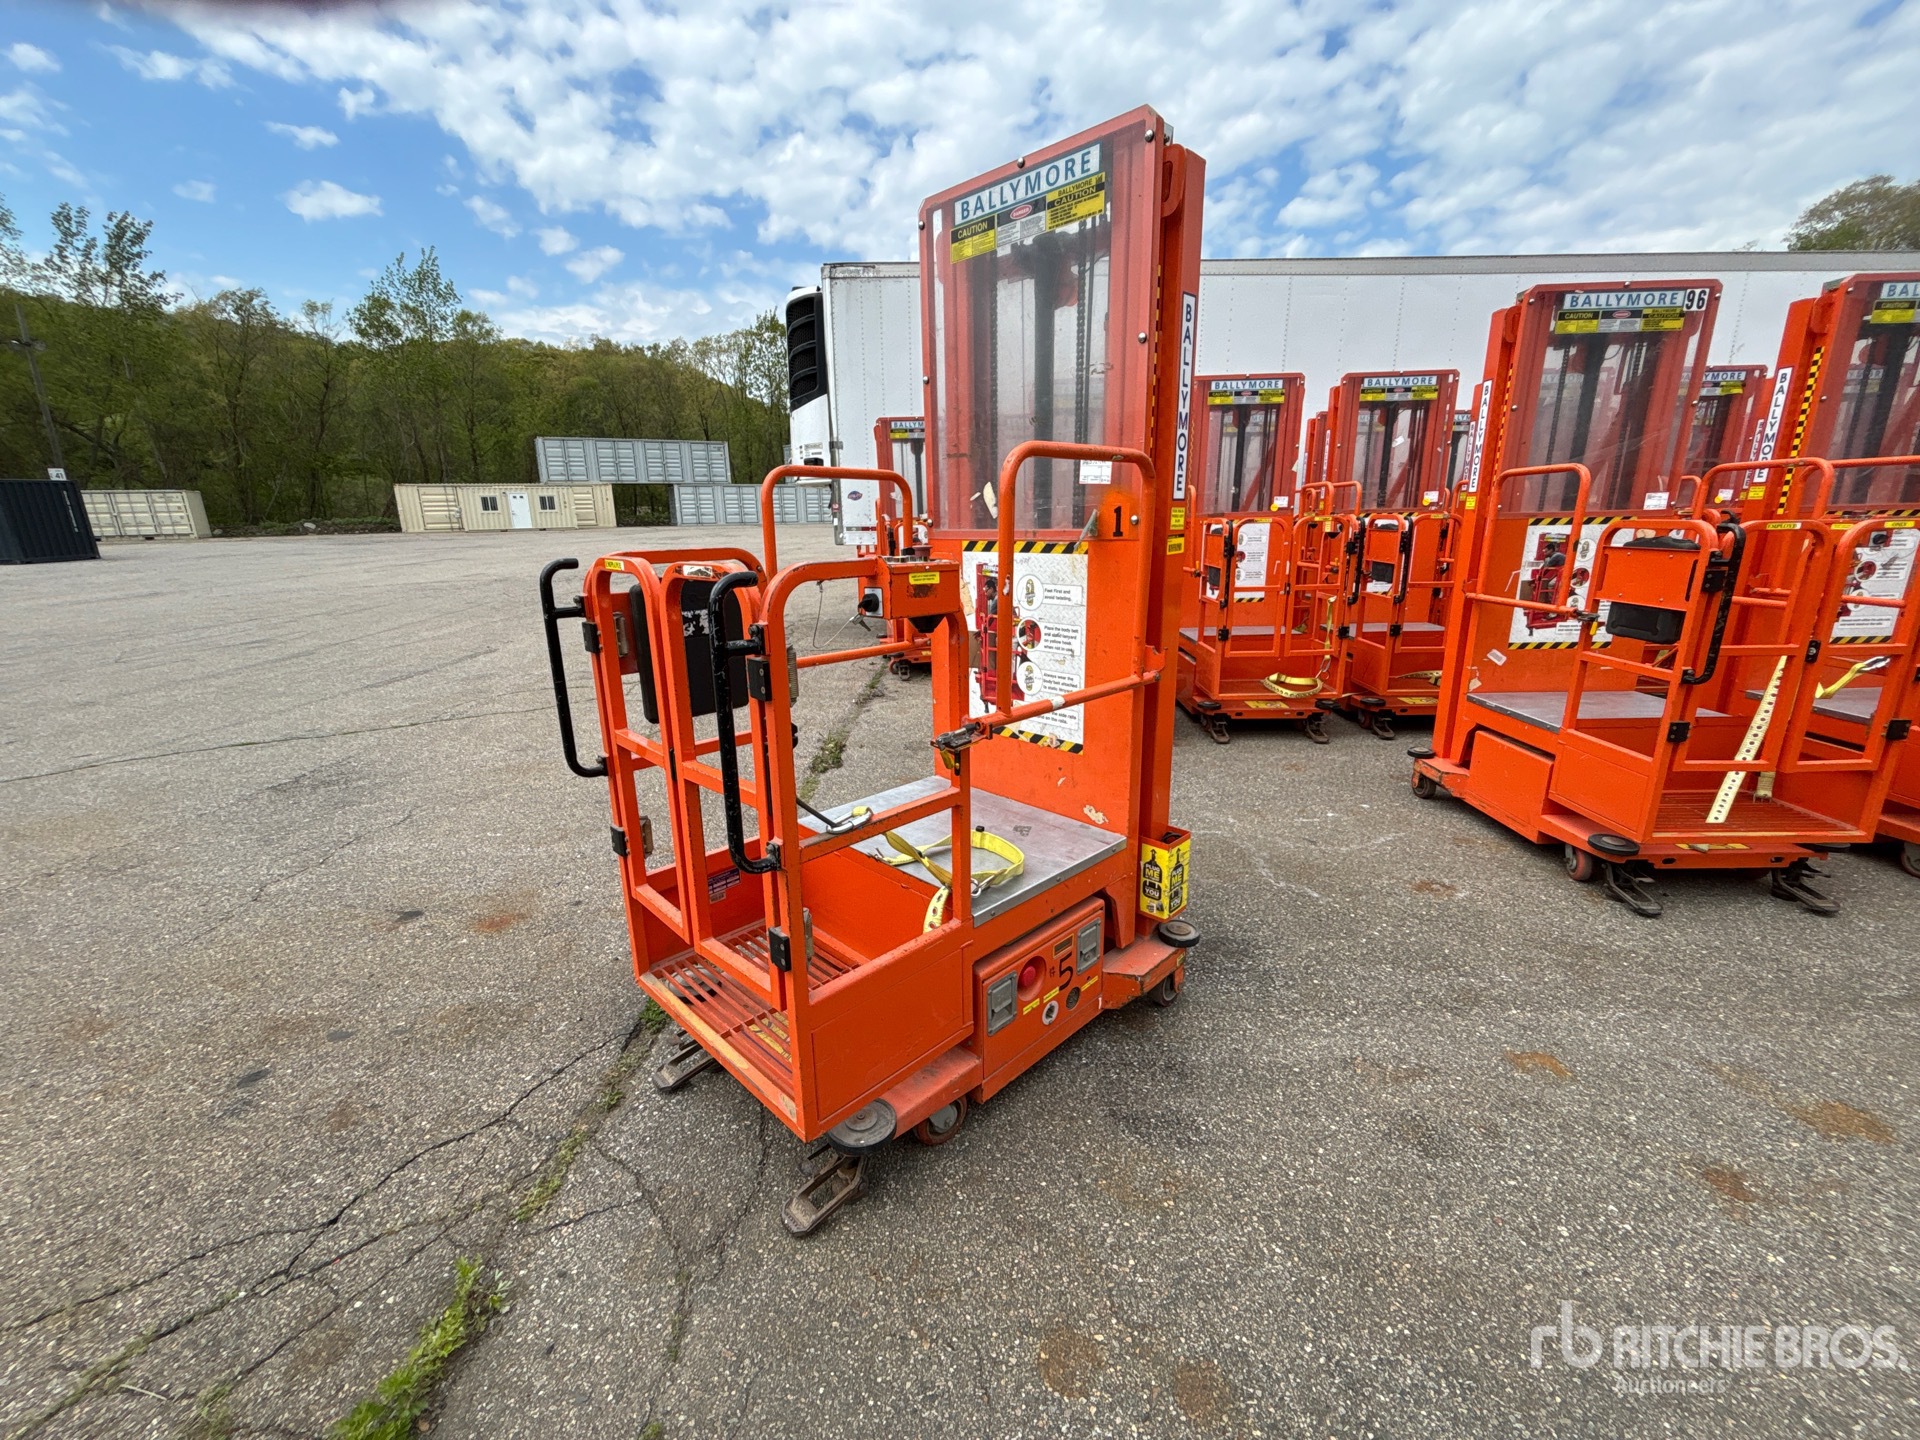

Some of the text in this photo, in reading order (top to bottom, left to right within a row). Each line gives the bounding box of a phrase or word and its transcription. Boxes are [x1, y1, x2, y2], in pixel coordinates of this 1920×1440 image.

[961, 150, 1092, 221] BALLYMORE
[1058, 178, 1093, 197] BALLYMORE
[1054, 186, 1097, 207] CAUTION
[957, 220, 988, 240] CAUTION
[1570, 292, 1679, 308] BALLYMORE
[1685, 289, 1707, 310] 96
[1214, 380, 1280, 390] BALLYMORE
[1367, 376, 1434, 387] BALLYMORE
[1176, 302, 1193, 493] BALLYMORE
[1757, 372, 1787, 479] BALLYMOE
[1471, 384, 1490, 489] BALLYMORE
[1112, 505, 1123, 538] 1
[1145, 863, 1161, 871] PLUG
[1145, 868, 1160, 879] ME
[1171, 872, 1183, 885] ME
[1145, 888, 1160, 897] YOU
